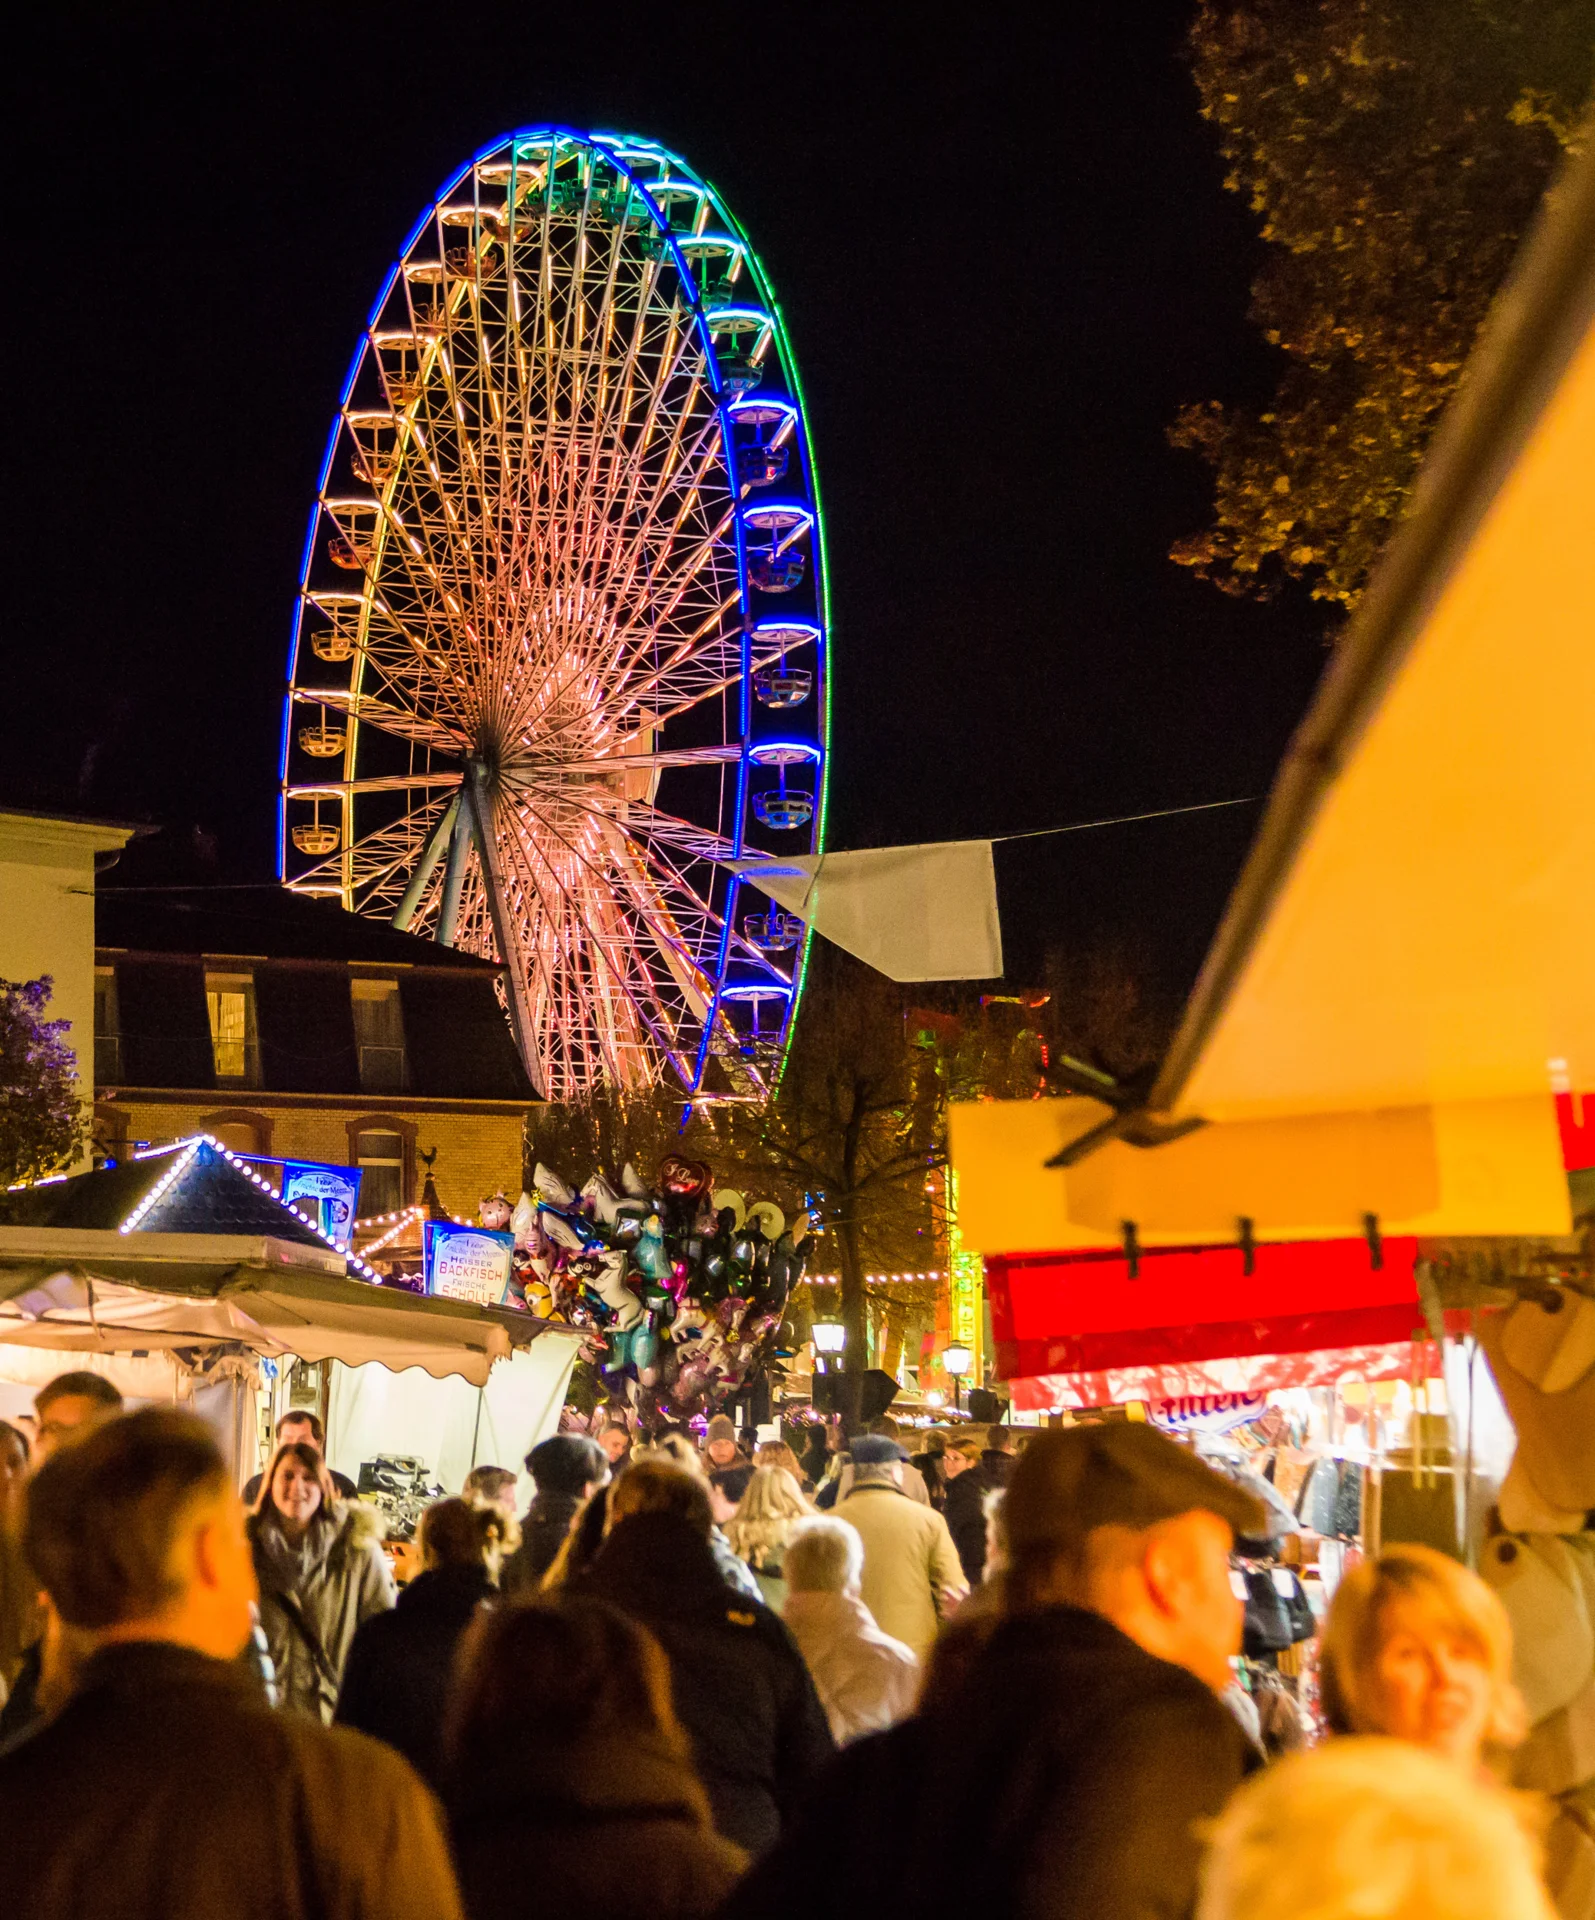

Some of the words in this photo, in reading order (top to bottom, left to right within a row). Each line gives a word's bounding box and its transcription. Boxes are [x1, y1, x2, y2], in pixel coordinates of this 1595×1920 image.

[450, 1255, 493, 1268] HEISSER
[439, 1261, 503, 1281] BACKFISCH
[453, 1278, 487, 1290] FRISCHE
[442, 1284, 496, 1303] SCHOLLE
